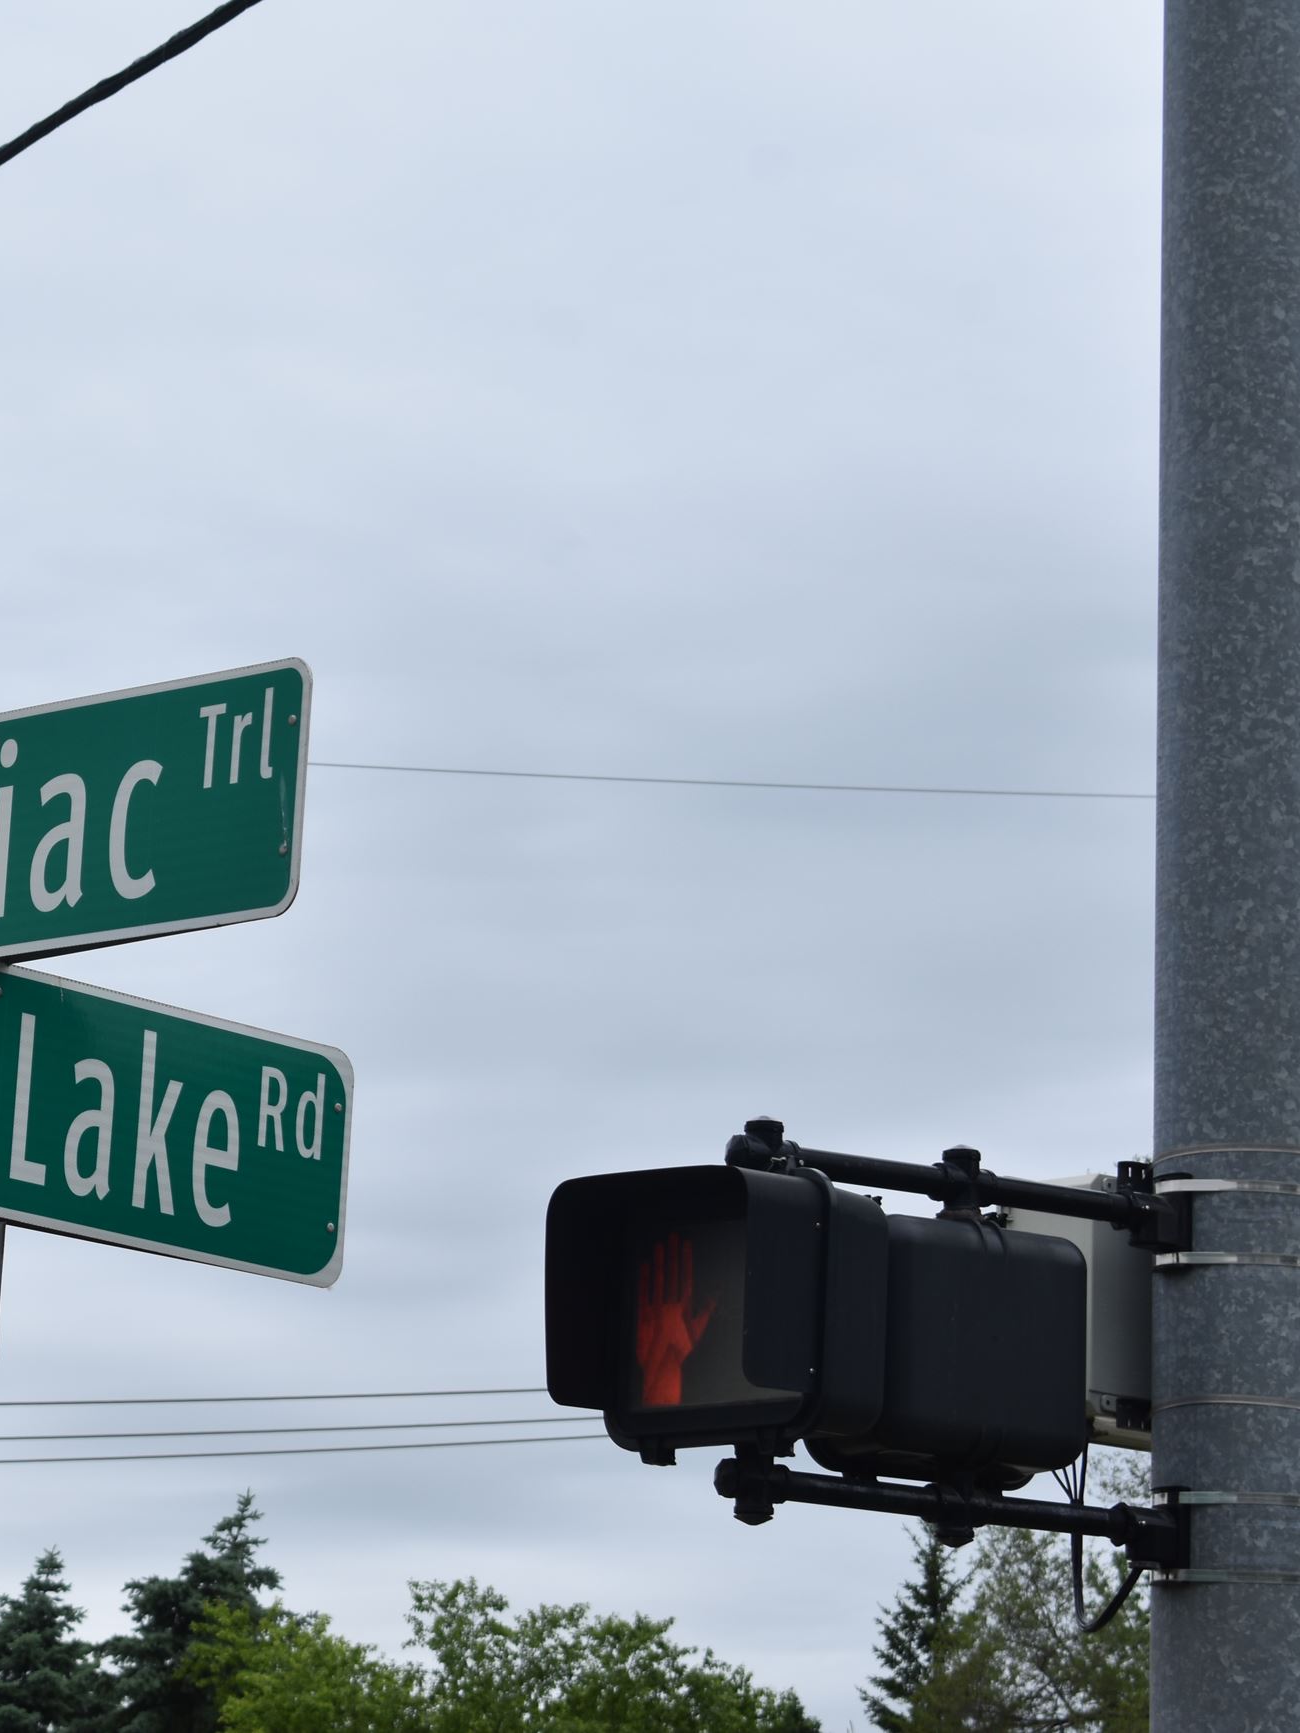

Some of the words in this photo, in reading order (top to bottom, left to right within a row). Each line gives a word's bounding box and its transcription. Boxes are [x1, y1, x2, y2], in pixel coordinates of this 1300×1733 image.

[199, 687, 274, 790] Trl
[8, 1012, 240, 1228] Lake
[257, 1065, 326, 1161] Rd
